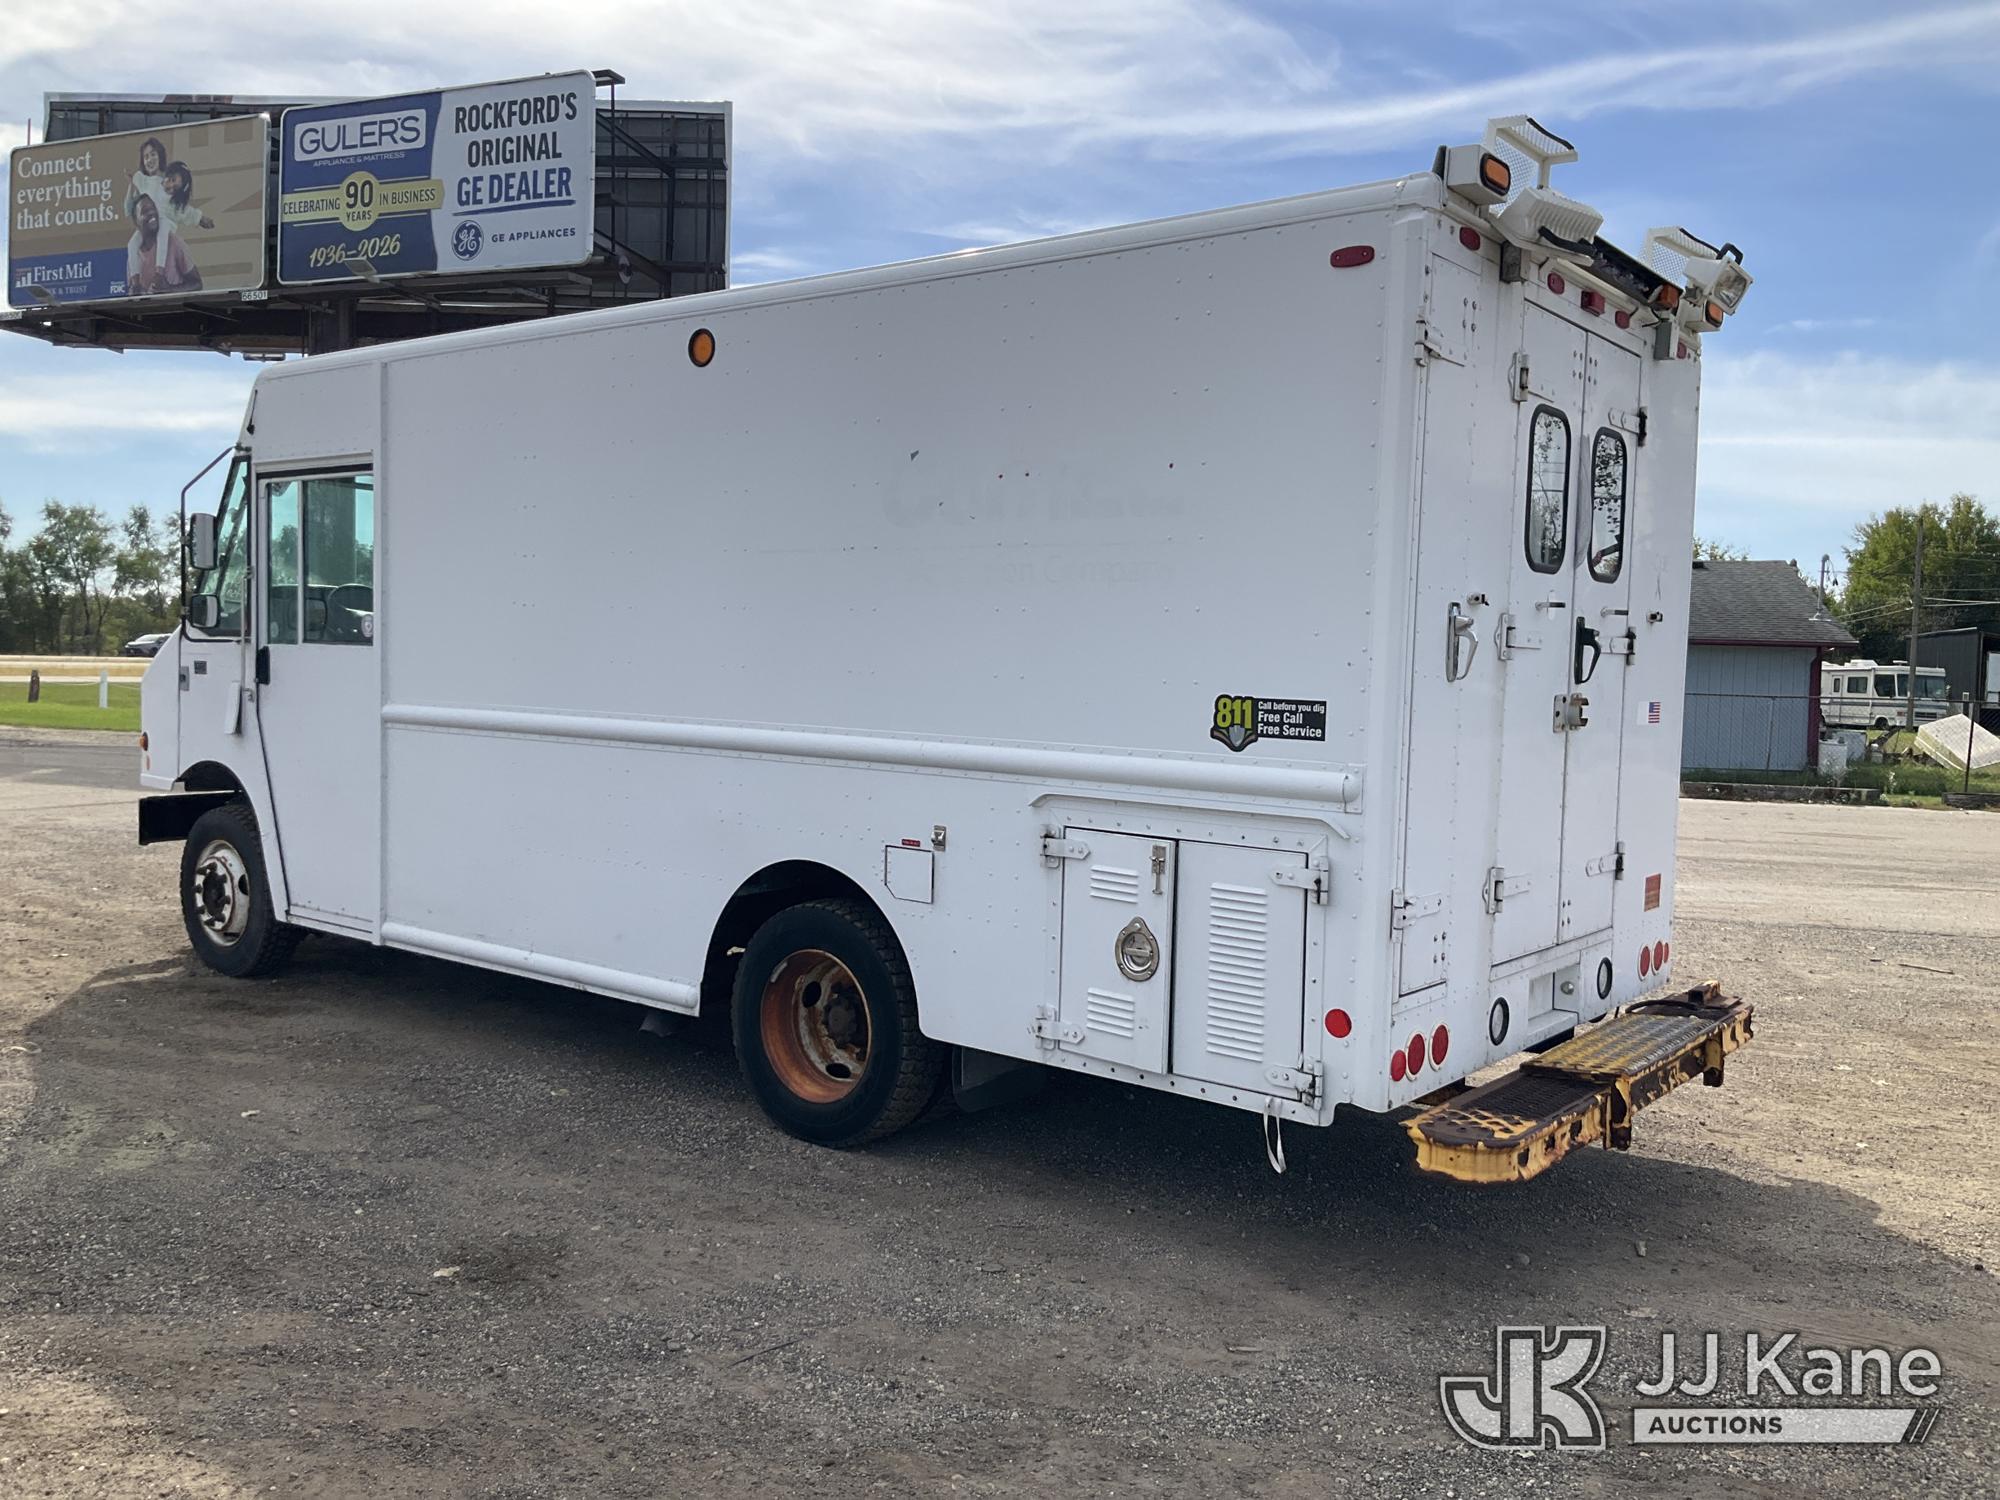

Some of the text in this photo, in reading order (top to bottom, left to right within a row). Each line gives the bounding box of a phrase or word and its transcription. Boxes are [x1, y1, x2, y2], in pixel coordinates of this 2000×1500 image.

[455, 92, 577, 134] ROCKFORD'S
[299, 115, 421, 155] GULER'S
[313, 157, 357, 167] APPLIANCE
[363, 151, 405, 162] MATTRESS
[467, 131, 562, 168] ORIGINAL
[17, 152, 91, 178] Connect
[16, 176, 112, 207] everything
[346, 180, 374, 209] 90
[379, 188, 436, 206] IN BUSINESS
[457, 167, 572, 207] GE DEALER
[16, 203, 119, 230] that counts.
[283, 197, 340, 215] CELEBRATING
[346, 210, 372, 222] YEARS
[491, 227, 576, 243] GE APPLIANCES
[34, 261, 92, 282] First Mid
[110, 285, 125, 294] FDIC
[1216, 697, 1252, 729] 811
[1258, 701, 1325, 714] Call before you dig
[1258, 711, 1303, 724] Free Call
[1257, 724, 1322, 737] Free Service
